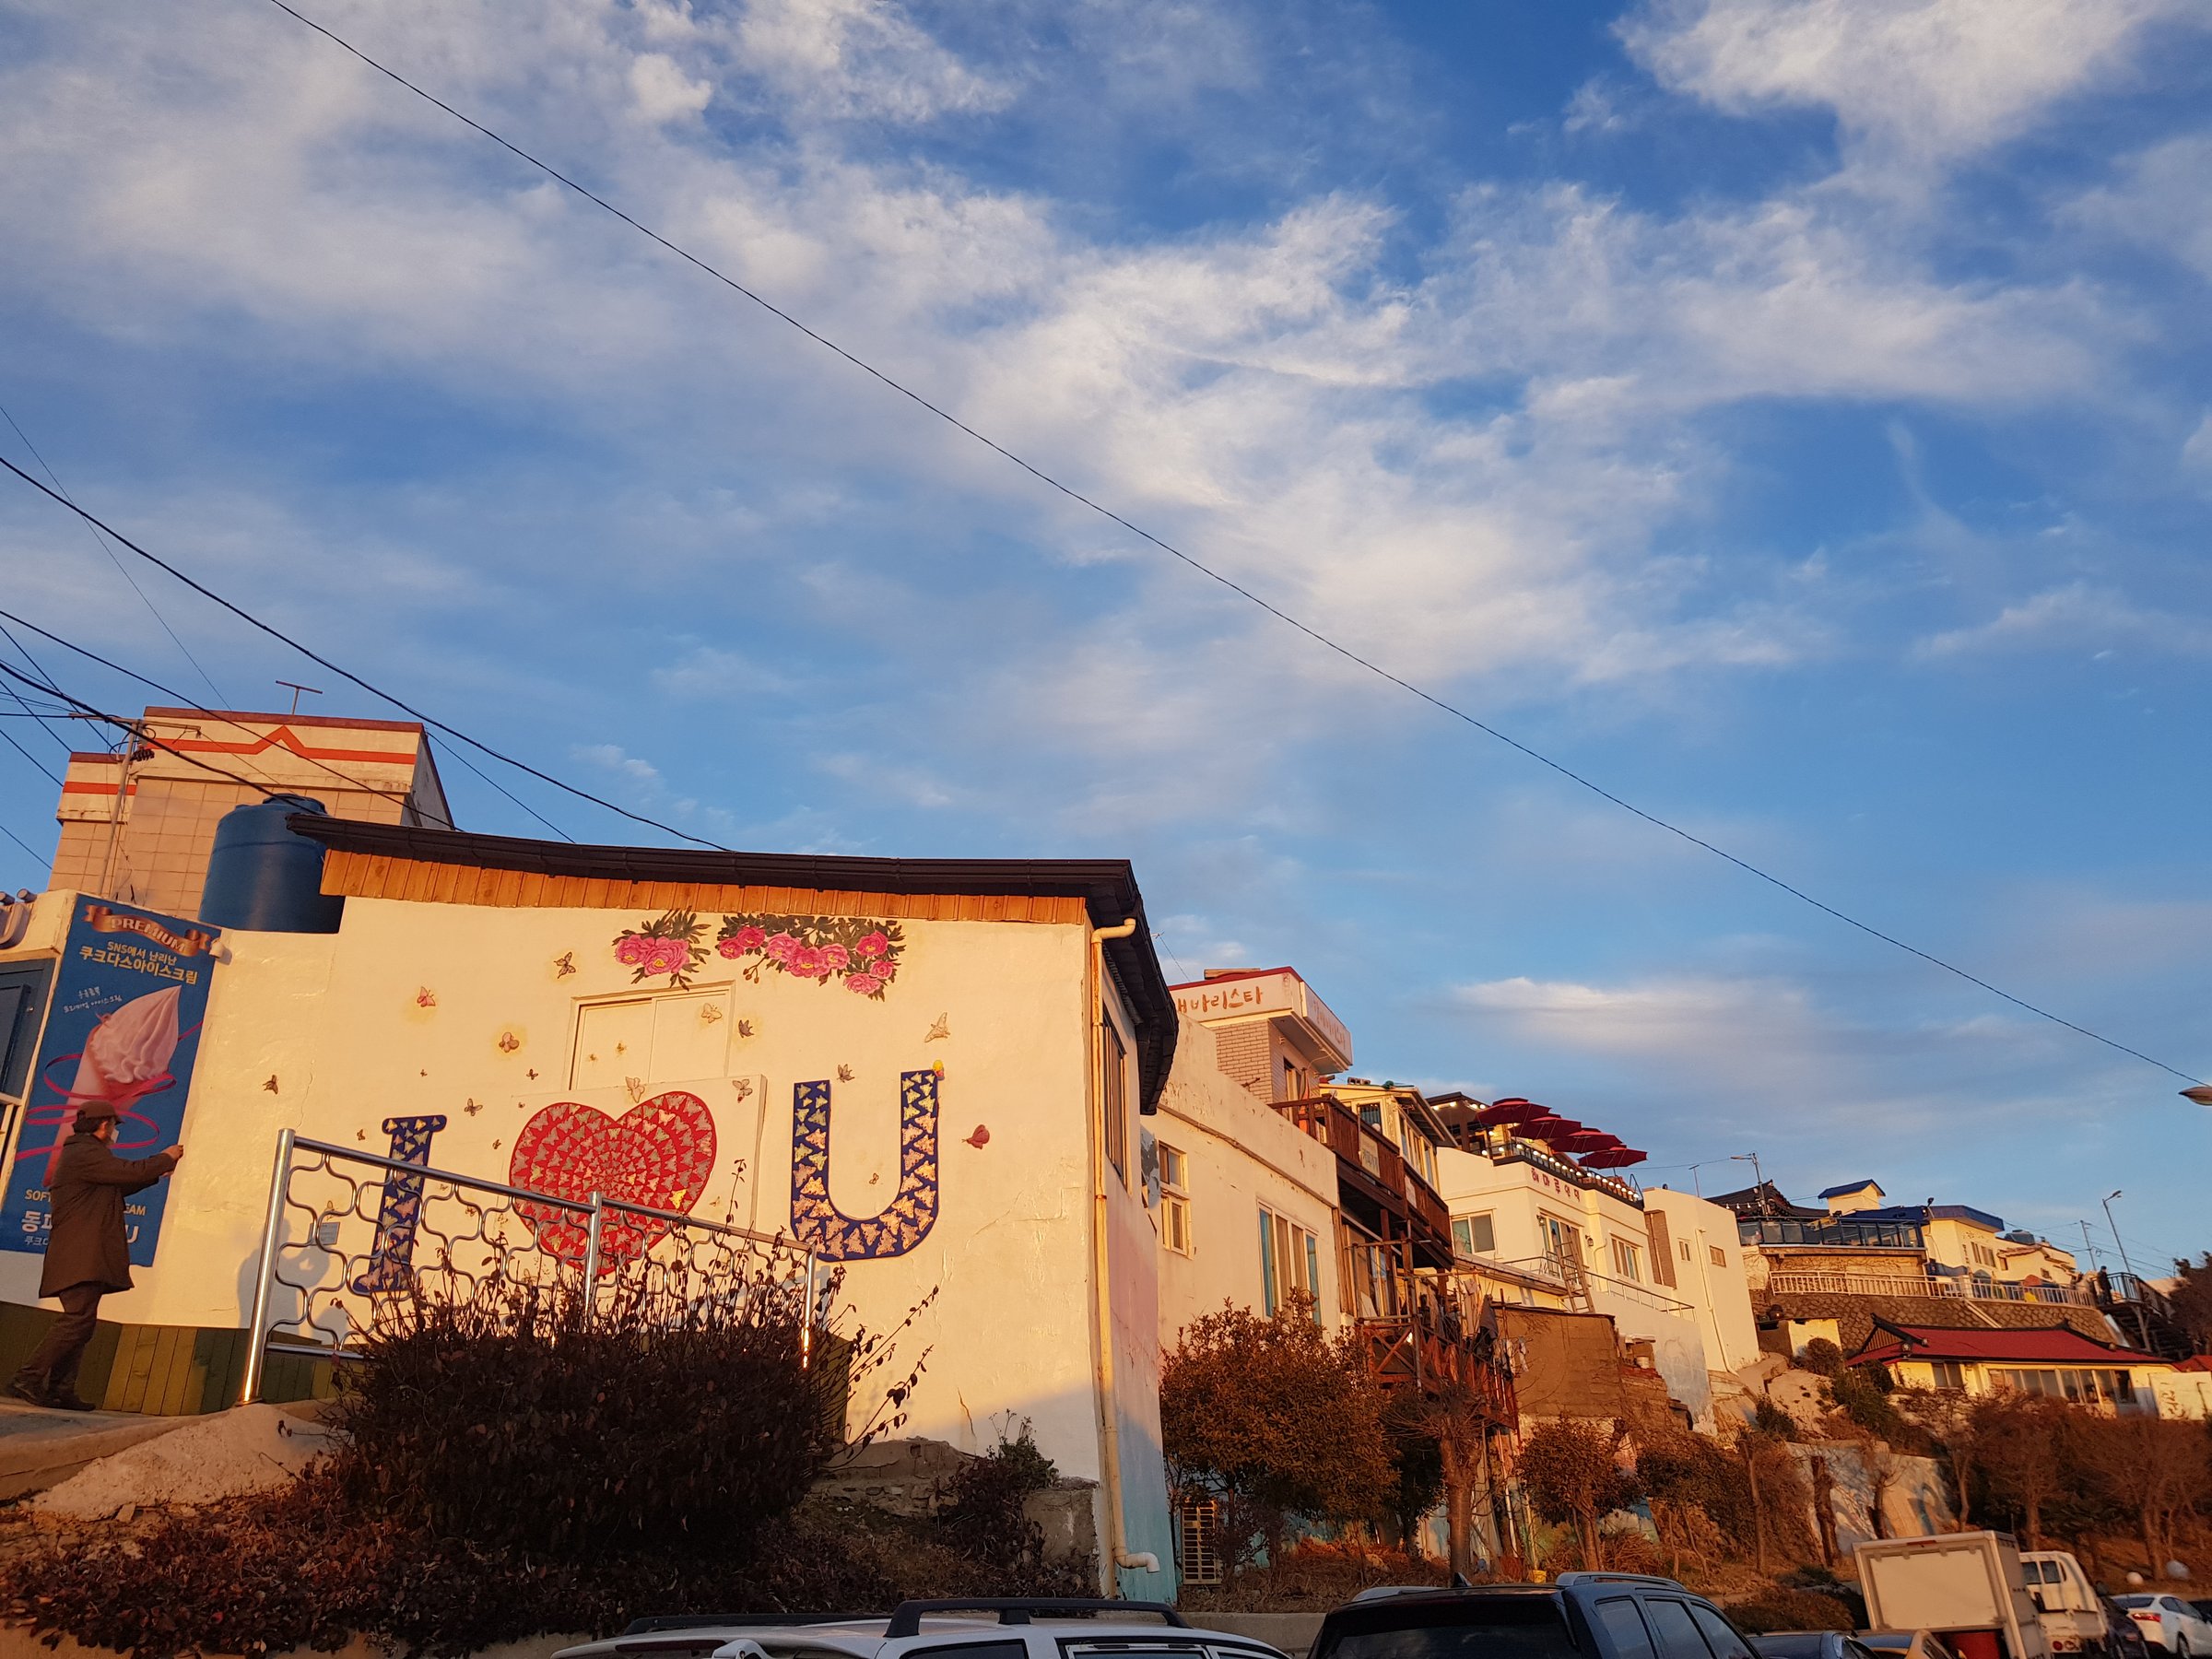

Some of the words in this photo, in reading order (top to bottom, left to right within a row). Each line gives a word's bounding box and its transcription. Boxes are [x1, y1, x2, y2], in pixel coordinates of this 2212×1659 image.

[111, 918, 185, 952] PREMIUM
[79, 946, 198, 985] 쿠크다스아이스크림
[107, 941, 147, 958] SNS에서
[149, 950, 177, 967] 난리난
[790, 1070, 938, 1263] U
